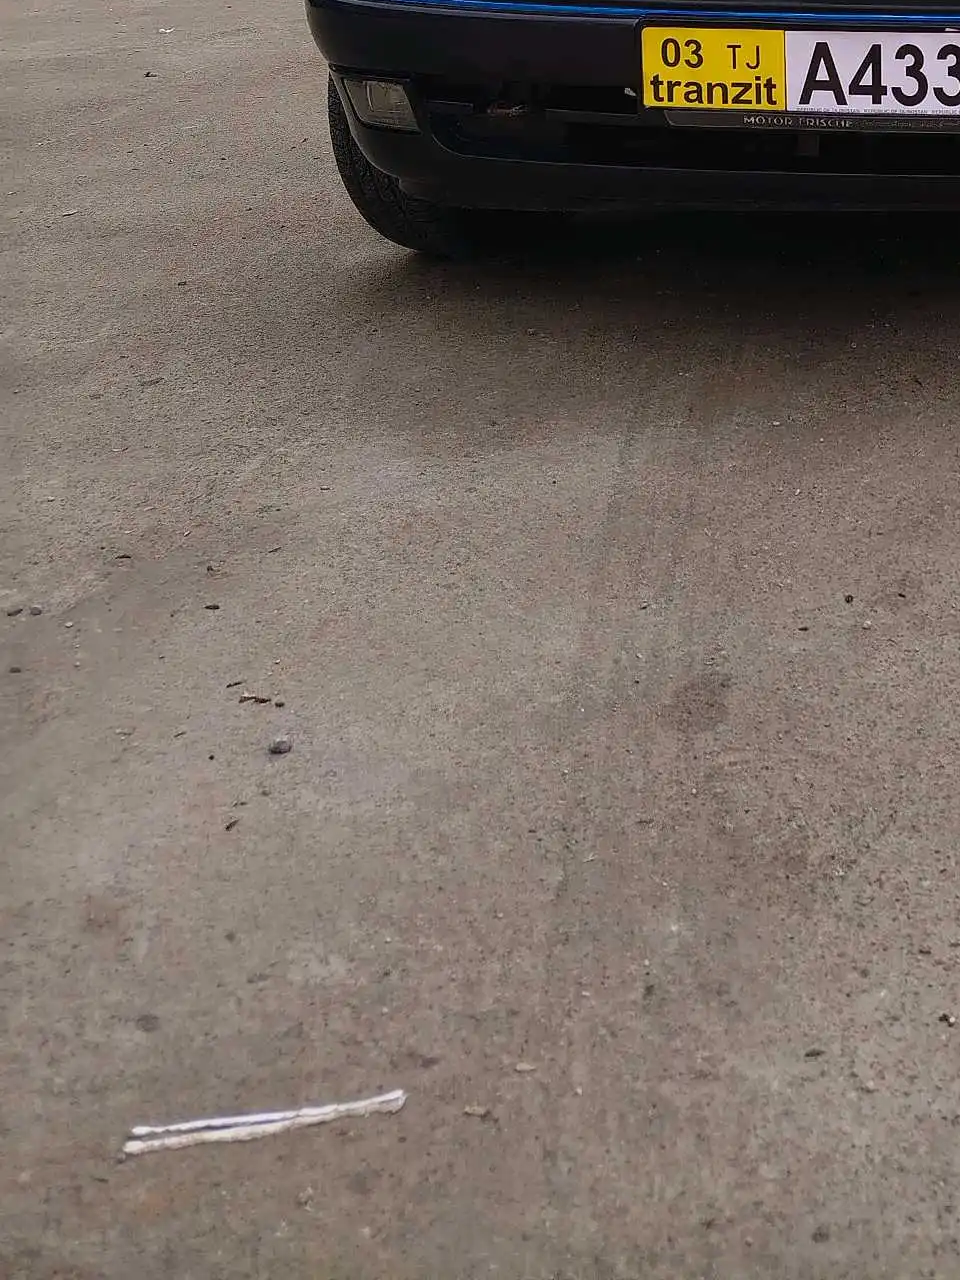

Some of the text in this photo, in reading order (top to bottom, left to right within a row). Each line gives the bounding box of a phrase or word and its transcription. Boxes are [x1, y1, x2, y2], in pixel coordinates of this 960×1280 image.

[661, 37, 761, 70] 03 TJ
[649, 73, 778, 106] tranzit
[743, 115, 793, 126] MOTOR
